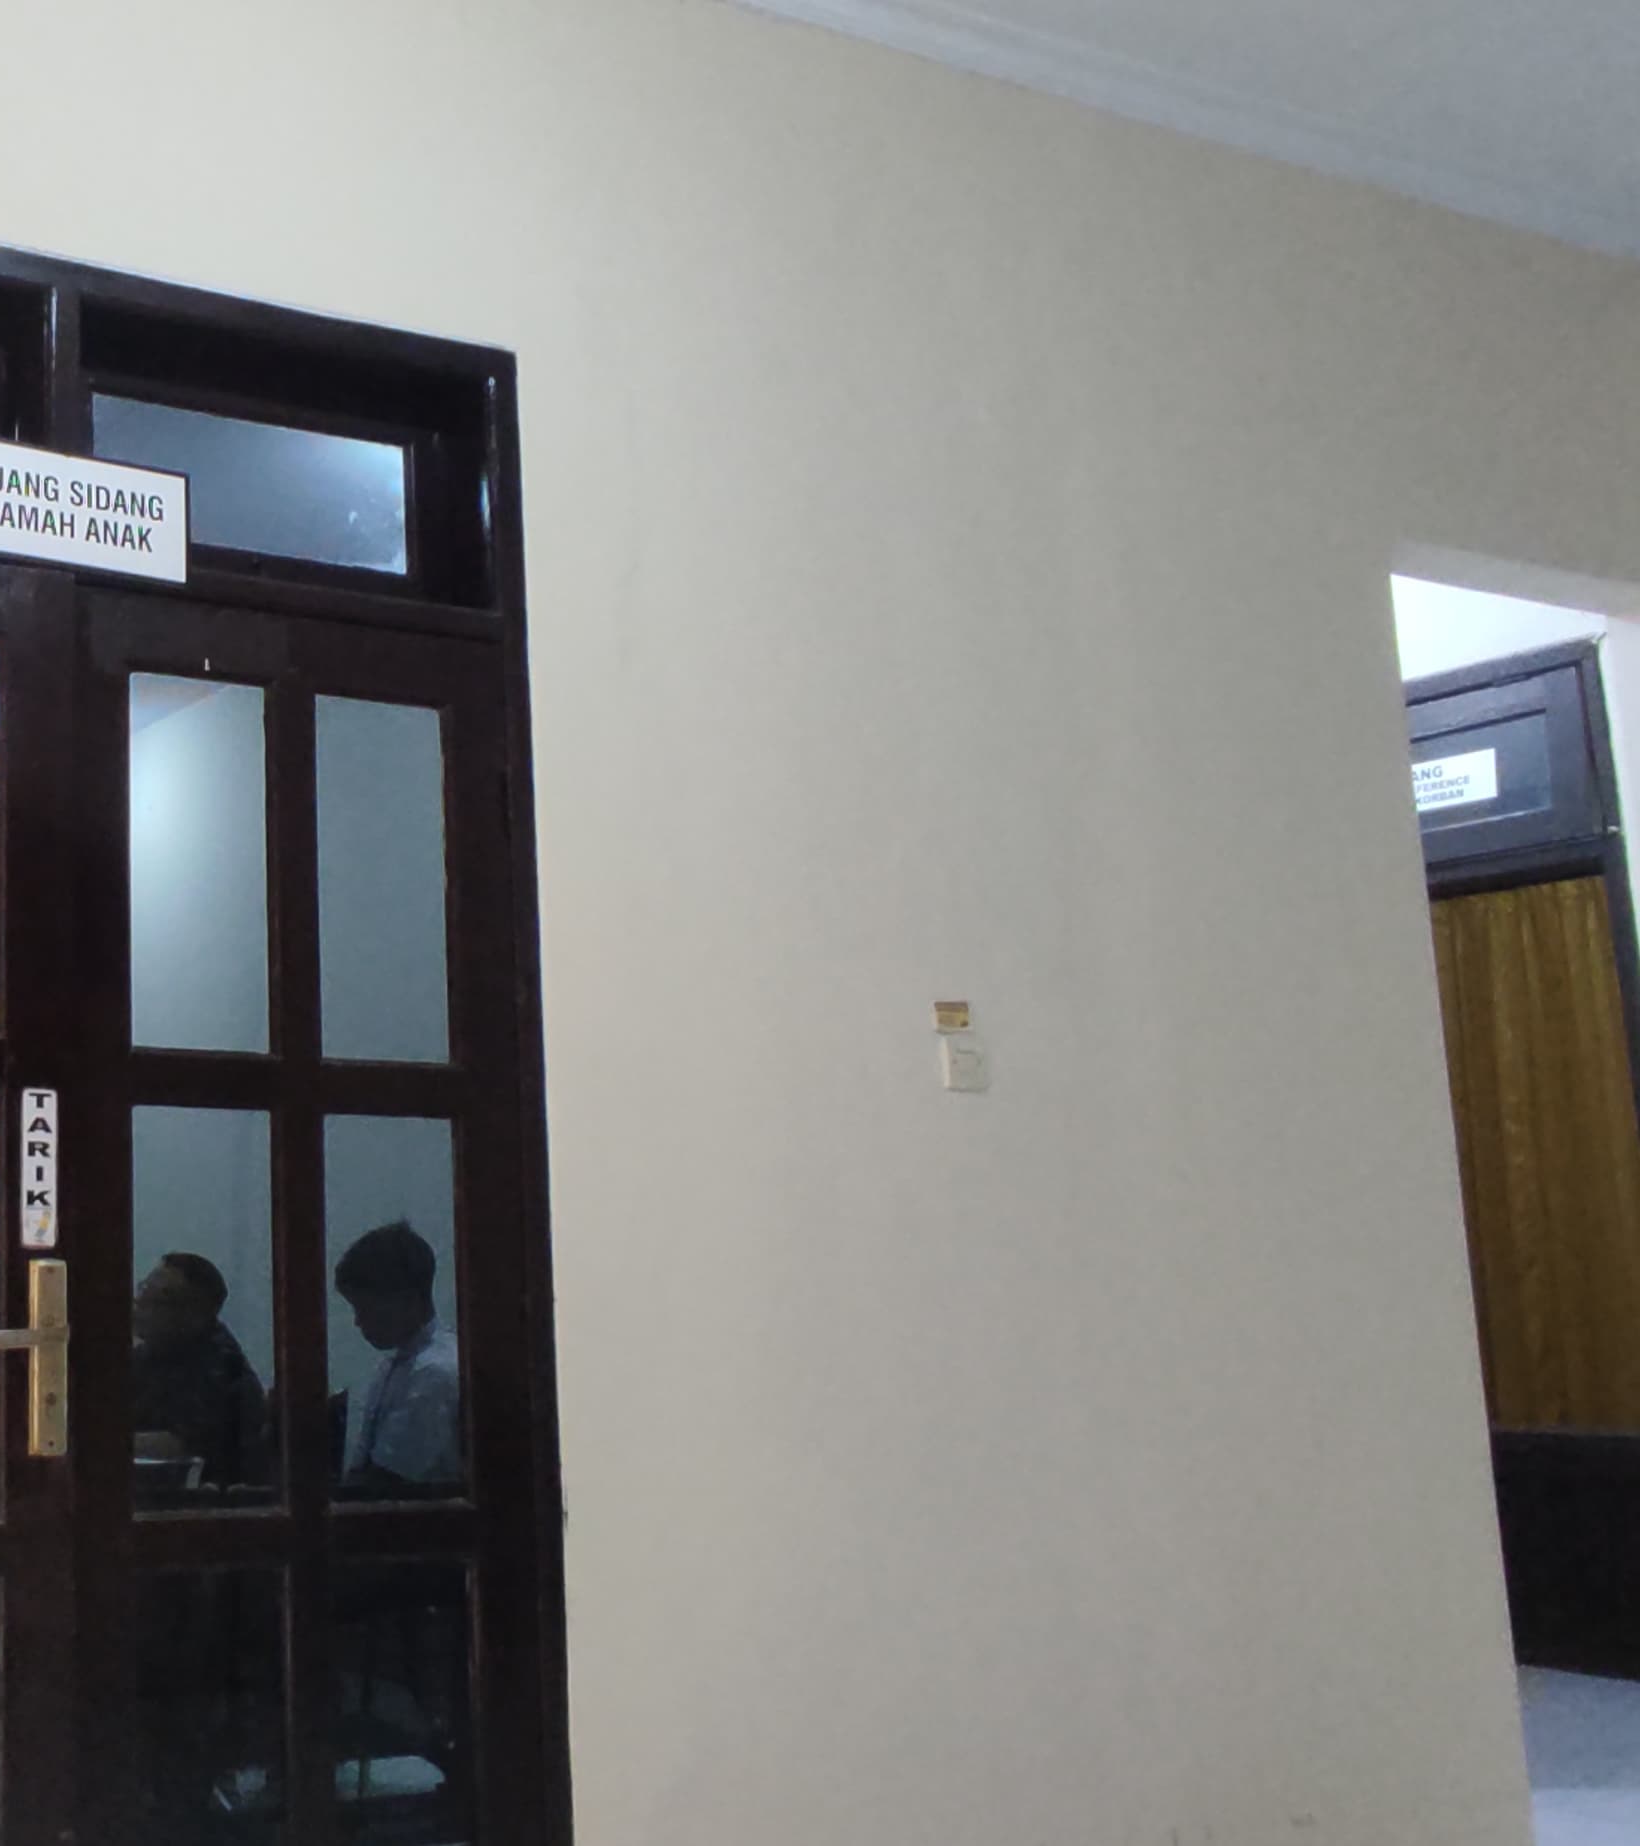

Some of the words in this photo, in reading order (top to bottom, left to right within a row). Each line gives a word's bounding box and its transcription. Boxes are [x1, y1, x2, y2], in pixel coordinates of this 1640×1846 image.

[69, 480, 164, 521] SIDANG
[85, 517, 153, 553] ANAK
[26, 1092, 53, 1207] TARIK
